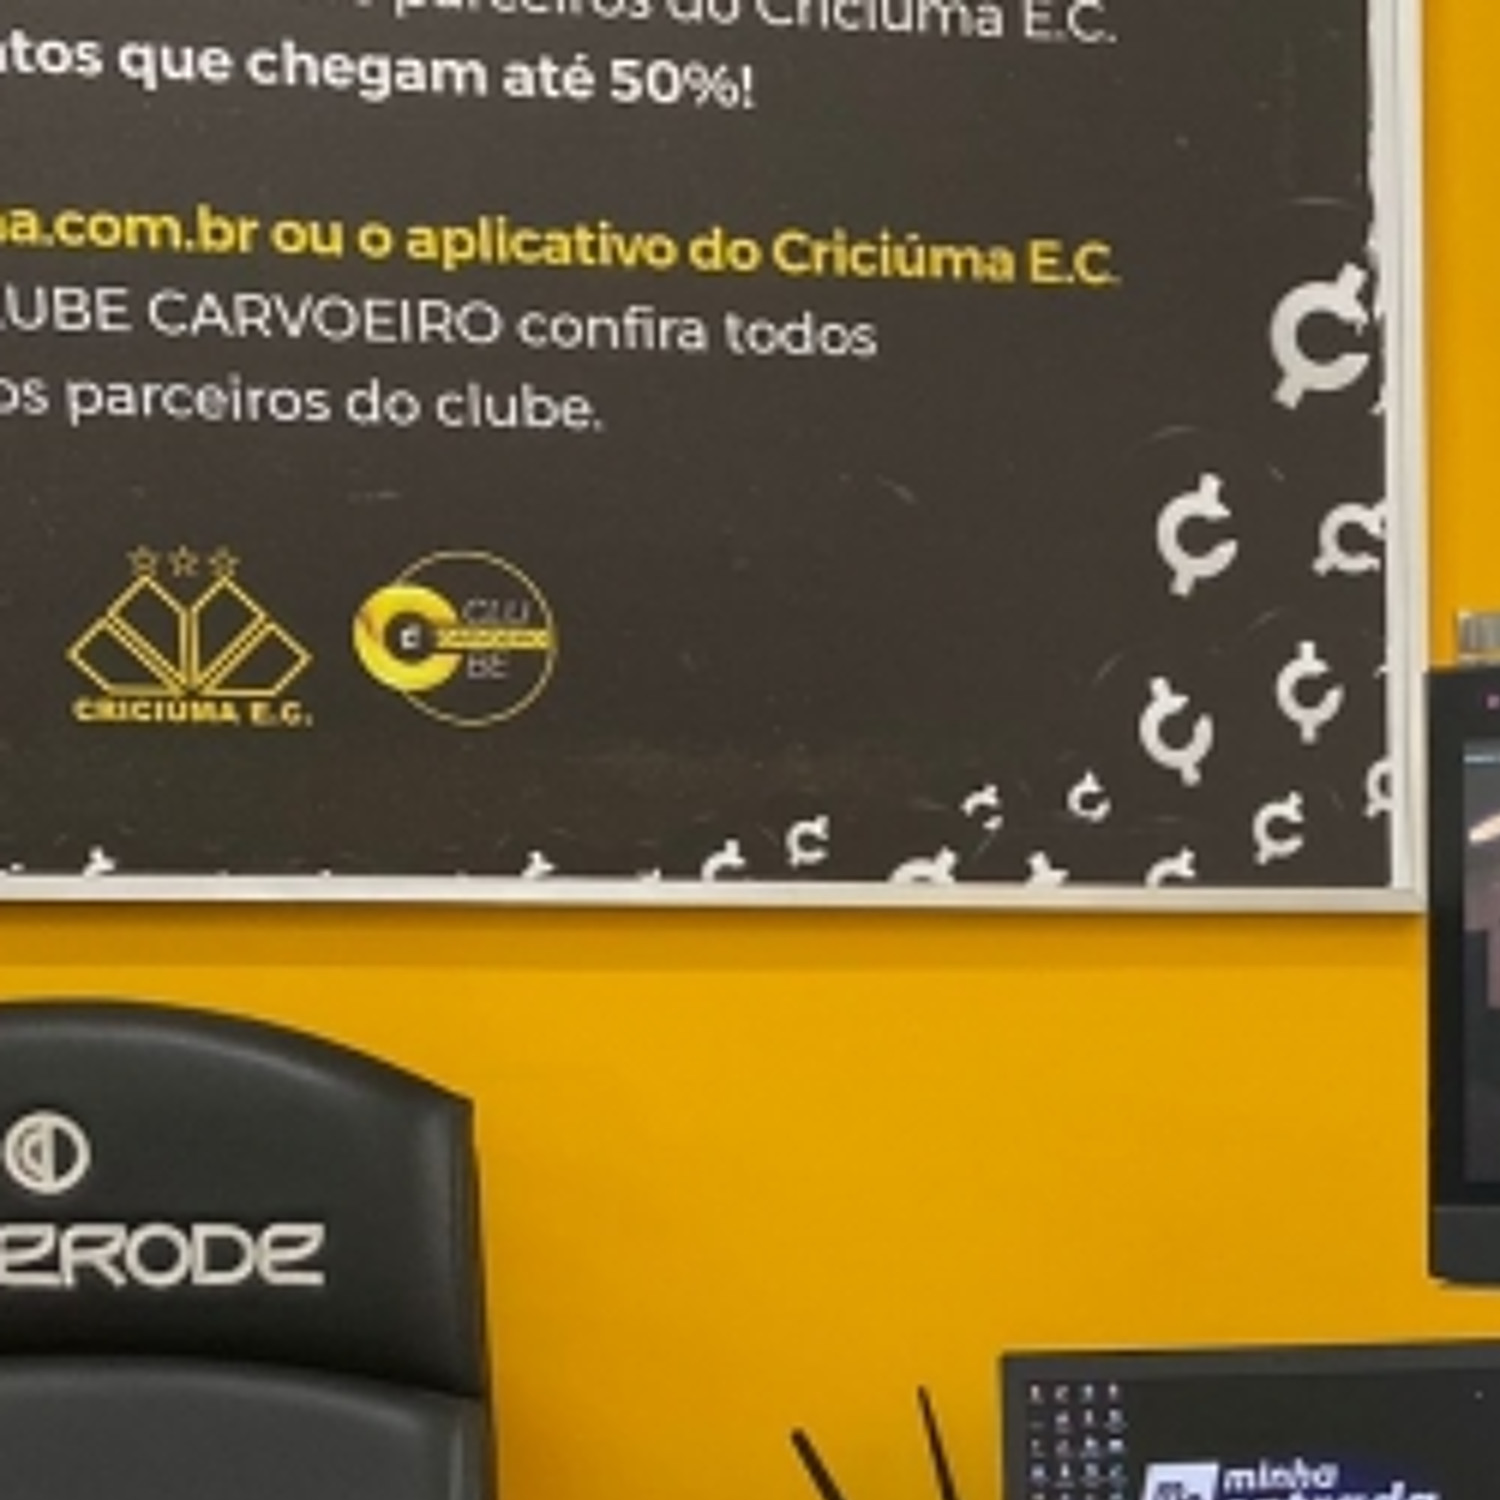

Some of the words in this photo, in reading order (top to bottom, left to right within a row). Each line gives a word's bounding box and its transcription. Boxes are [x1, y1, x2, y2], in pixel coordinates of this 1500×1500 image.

[0, 29, 104, 77] tos
[118, 42, 234, 91] que
[245, 39, 488, 103] chegam
[503, 54, 596, 100] até
[610, 58, 753, 109] 50%!
[0, 204, 260, 253] a.com.br
[270, 220, 344, 257] ou
[357, 222, 394, 259] o
[406, 215, 679, 271] aplicativo
[688, 226, 763, 272] do
[773, 228, 1015, 282] Criciúma
[0, 284, 132, 332] UBE
[148, 288, 503, 344] CARVOEIRO
[516, 305, 708, 351] confira
[724, 311, 878, 357] todos
[66, 375, 332, 427] parceiros
[346, 377, 421, 426] do
[435, 382, 604, 432] clube.
[1222, 1456, 1340, 1491] minha
